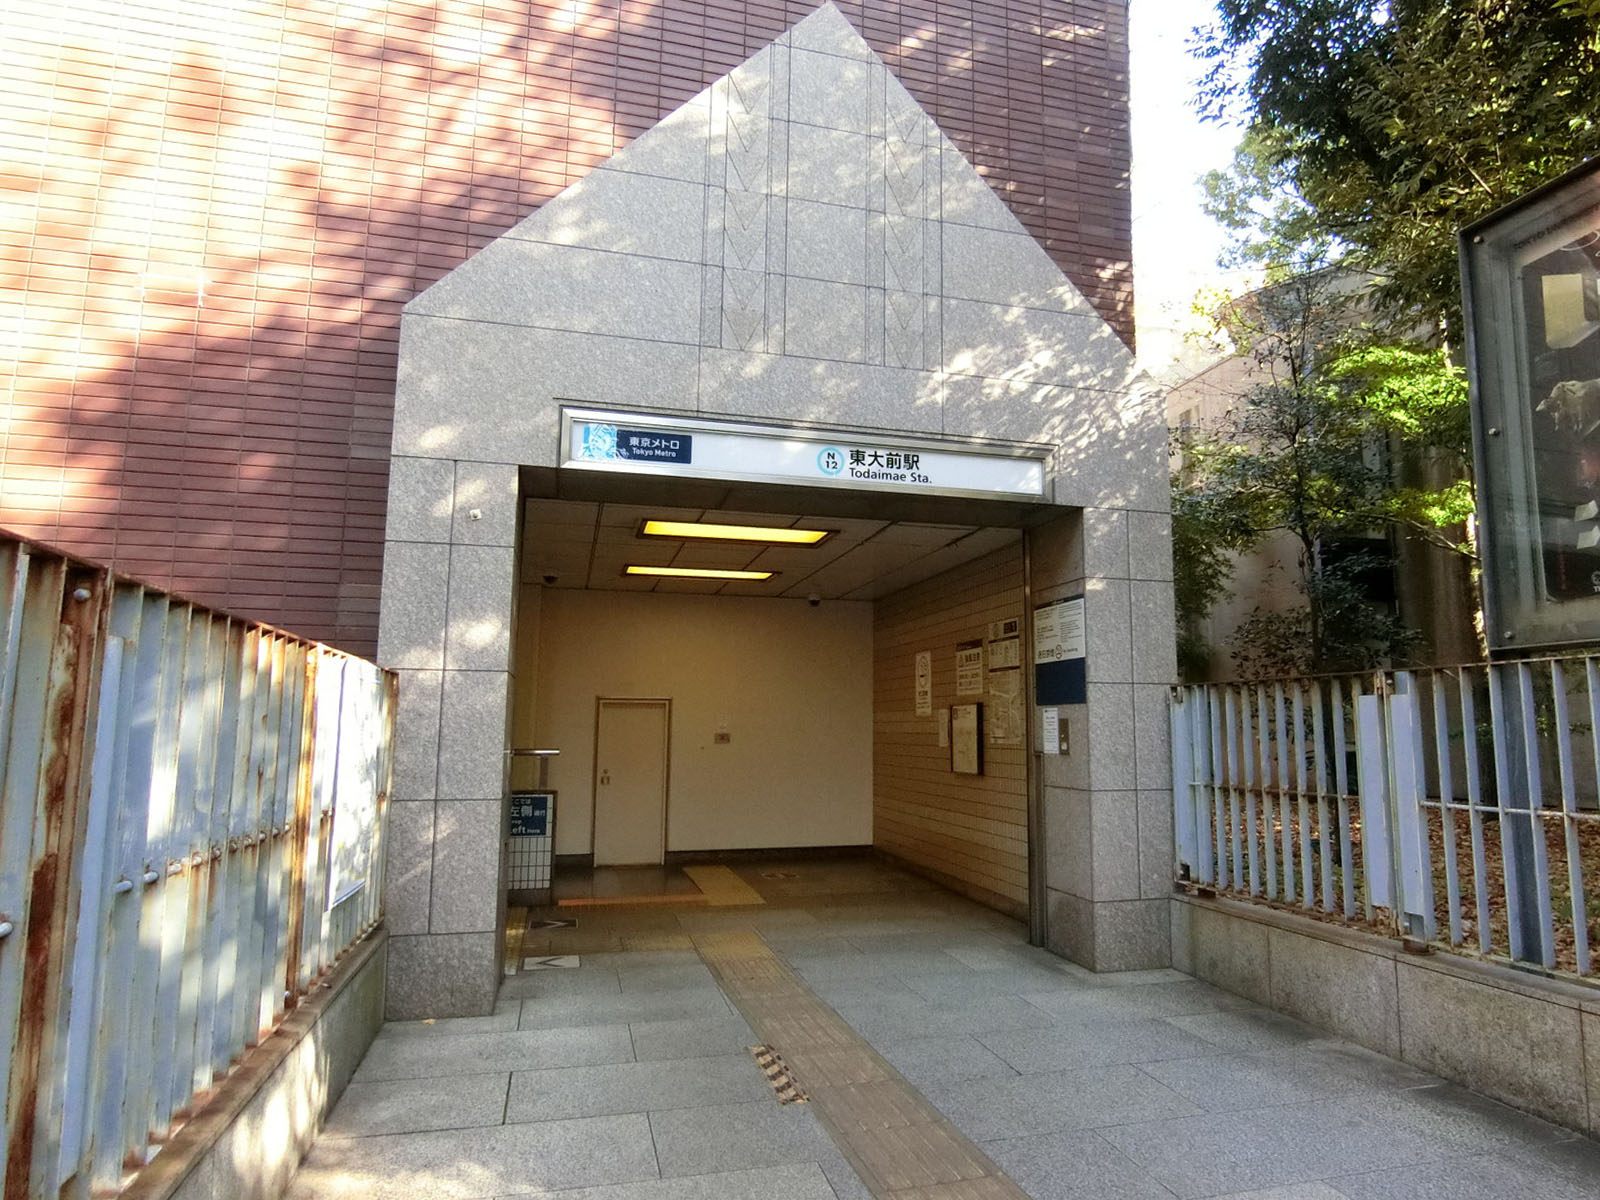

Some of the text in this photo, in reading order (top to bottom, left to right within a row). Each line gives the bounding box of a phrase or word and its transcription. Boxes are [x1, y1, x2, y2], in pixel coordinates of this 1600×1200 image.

[629, 437, 680, 449] 東京メトロ
[632, 447, 677, 457] Tokyo Metro
[827, 452, 835, 460] N
[826, 461, 838, 469] 12
[849, 449, 920, 470] 東大前駅
[849, 467, 932, 484] Todaimae Sta.
